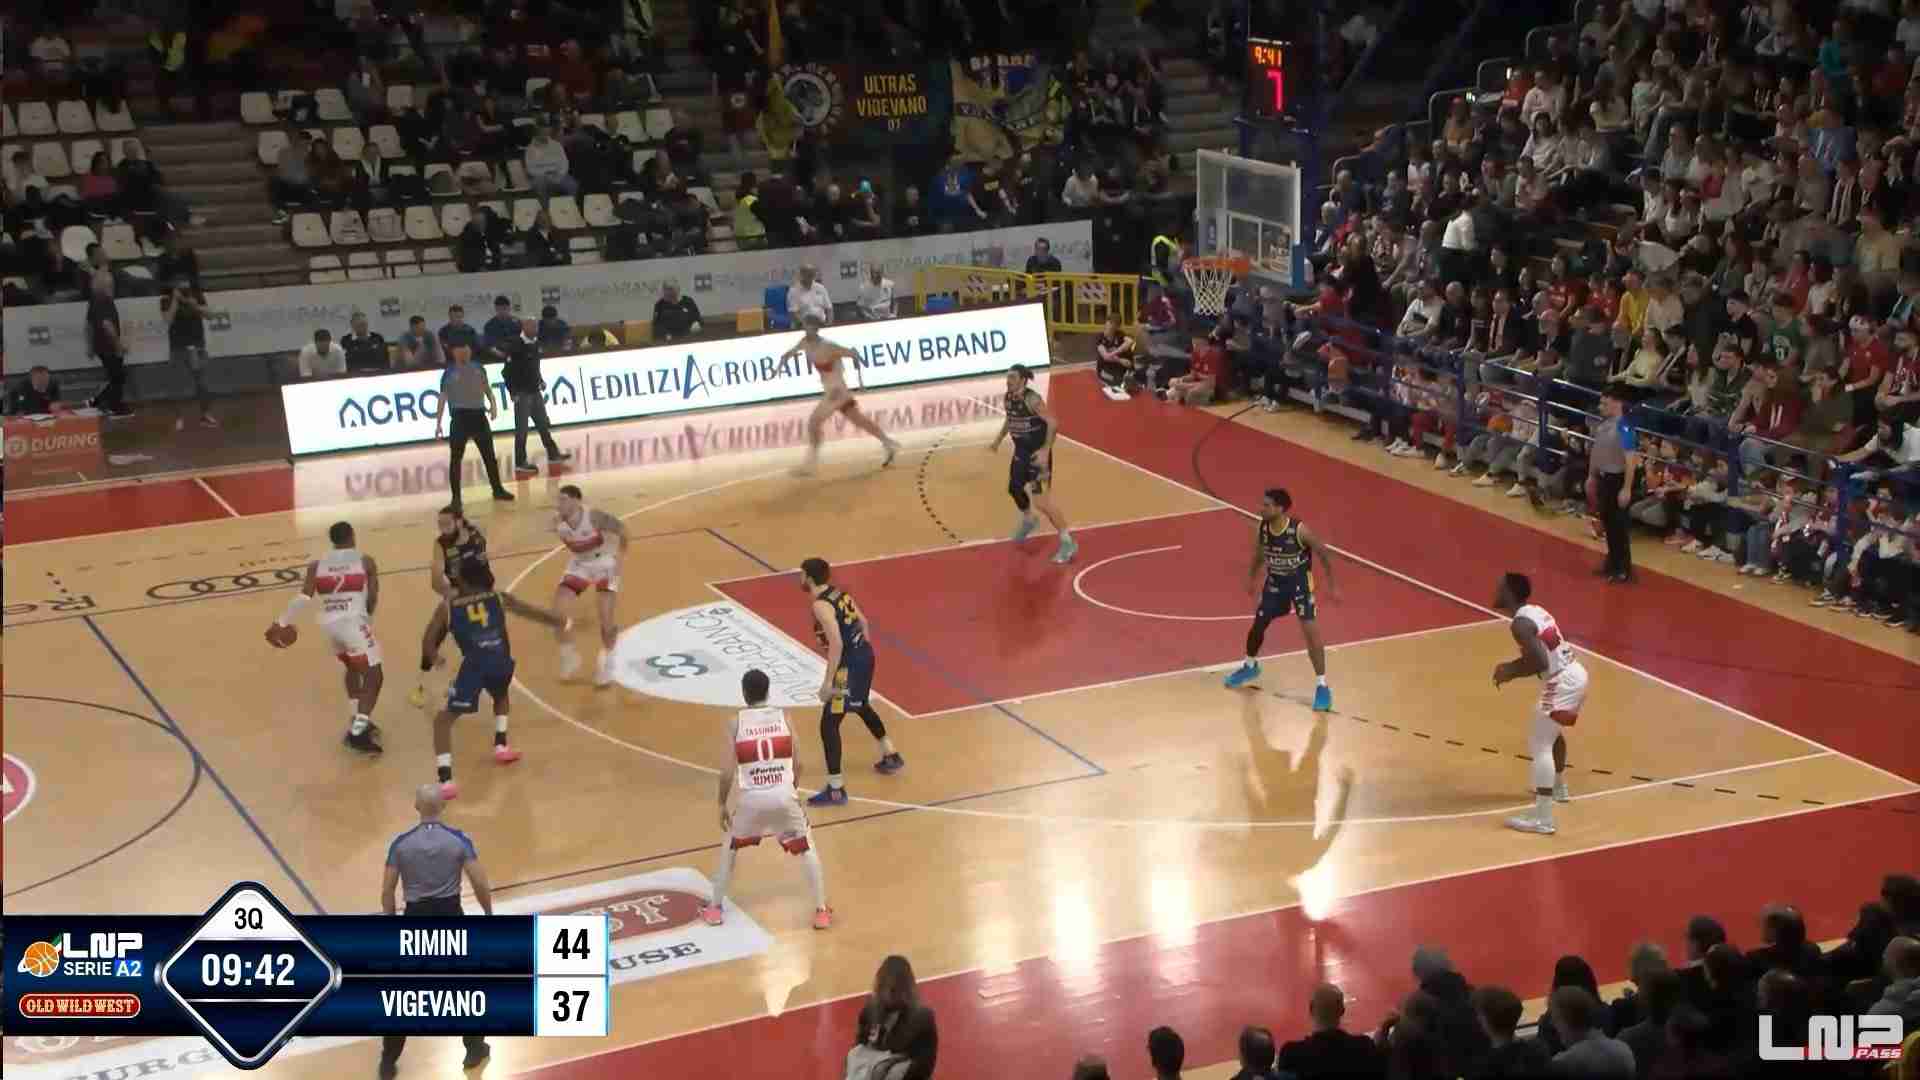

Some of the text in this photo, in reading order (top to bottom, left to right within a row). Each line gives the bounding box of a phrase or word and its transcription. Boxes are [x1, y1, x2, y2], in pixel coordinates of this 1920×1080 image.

[863, 73, 917, 93] ULTRAS
[855, 329, 1007, 369] NEW BRAND
[31, 433, 97, 452] DURING
[466, 603, 489, 626] 4
[757, 738, 774, 760] 0
